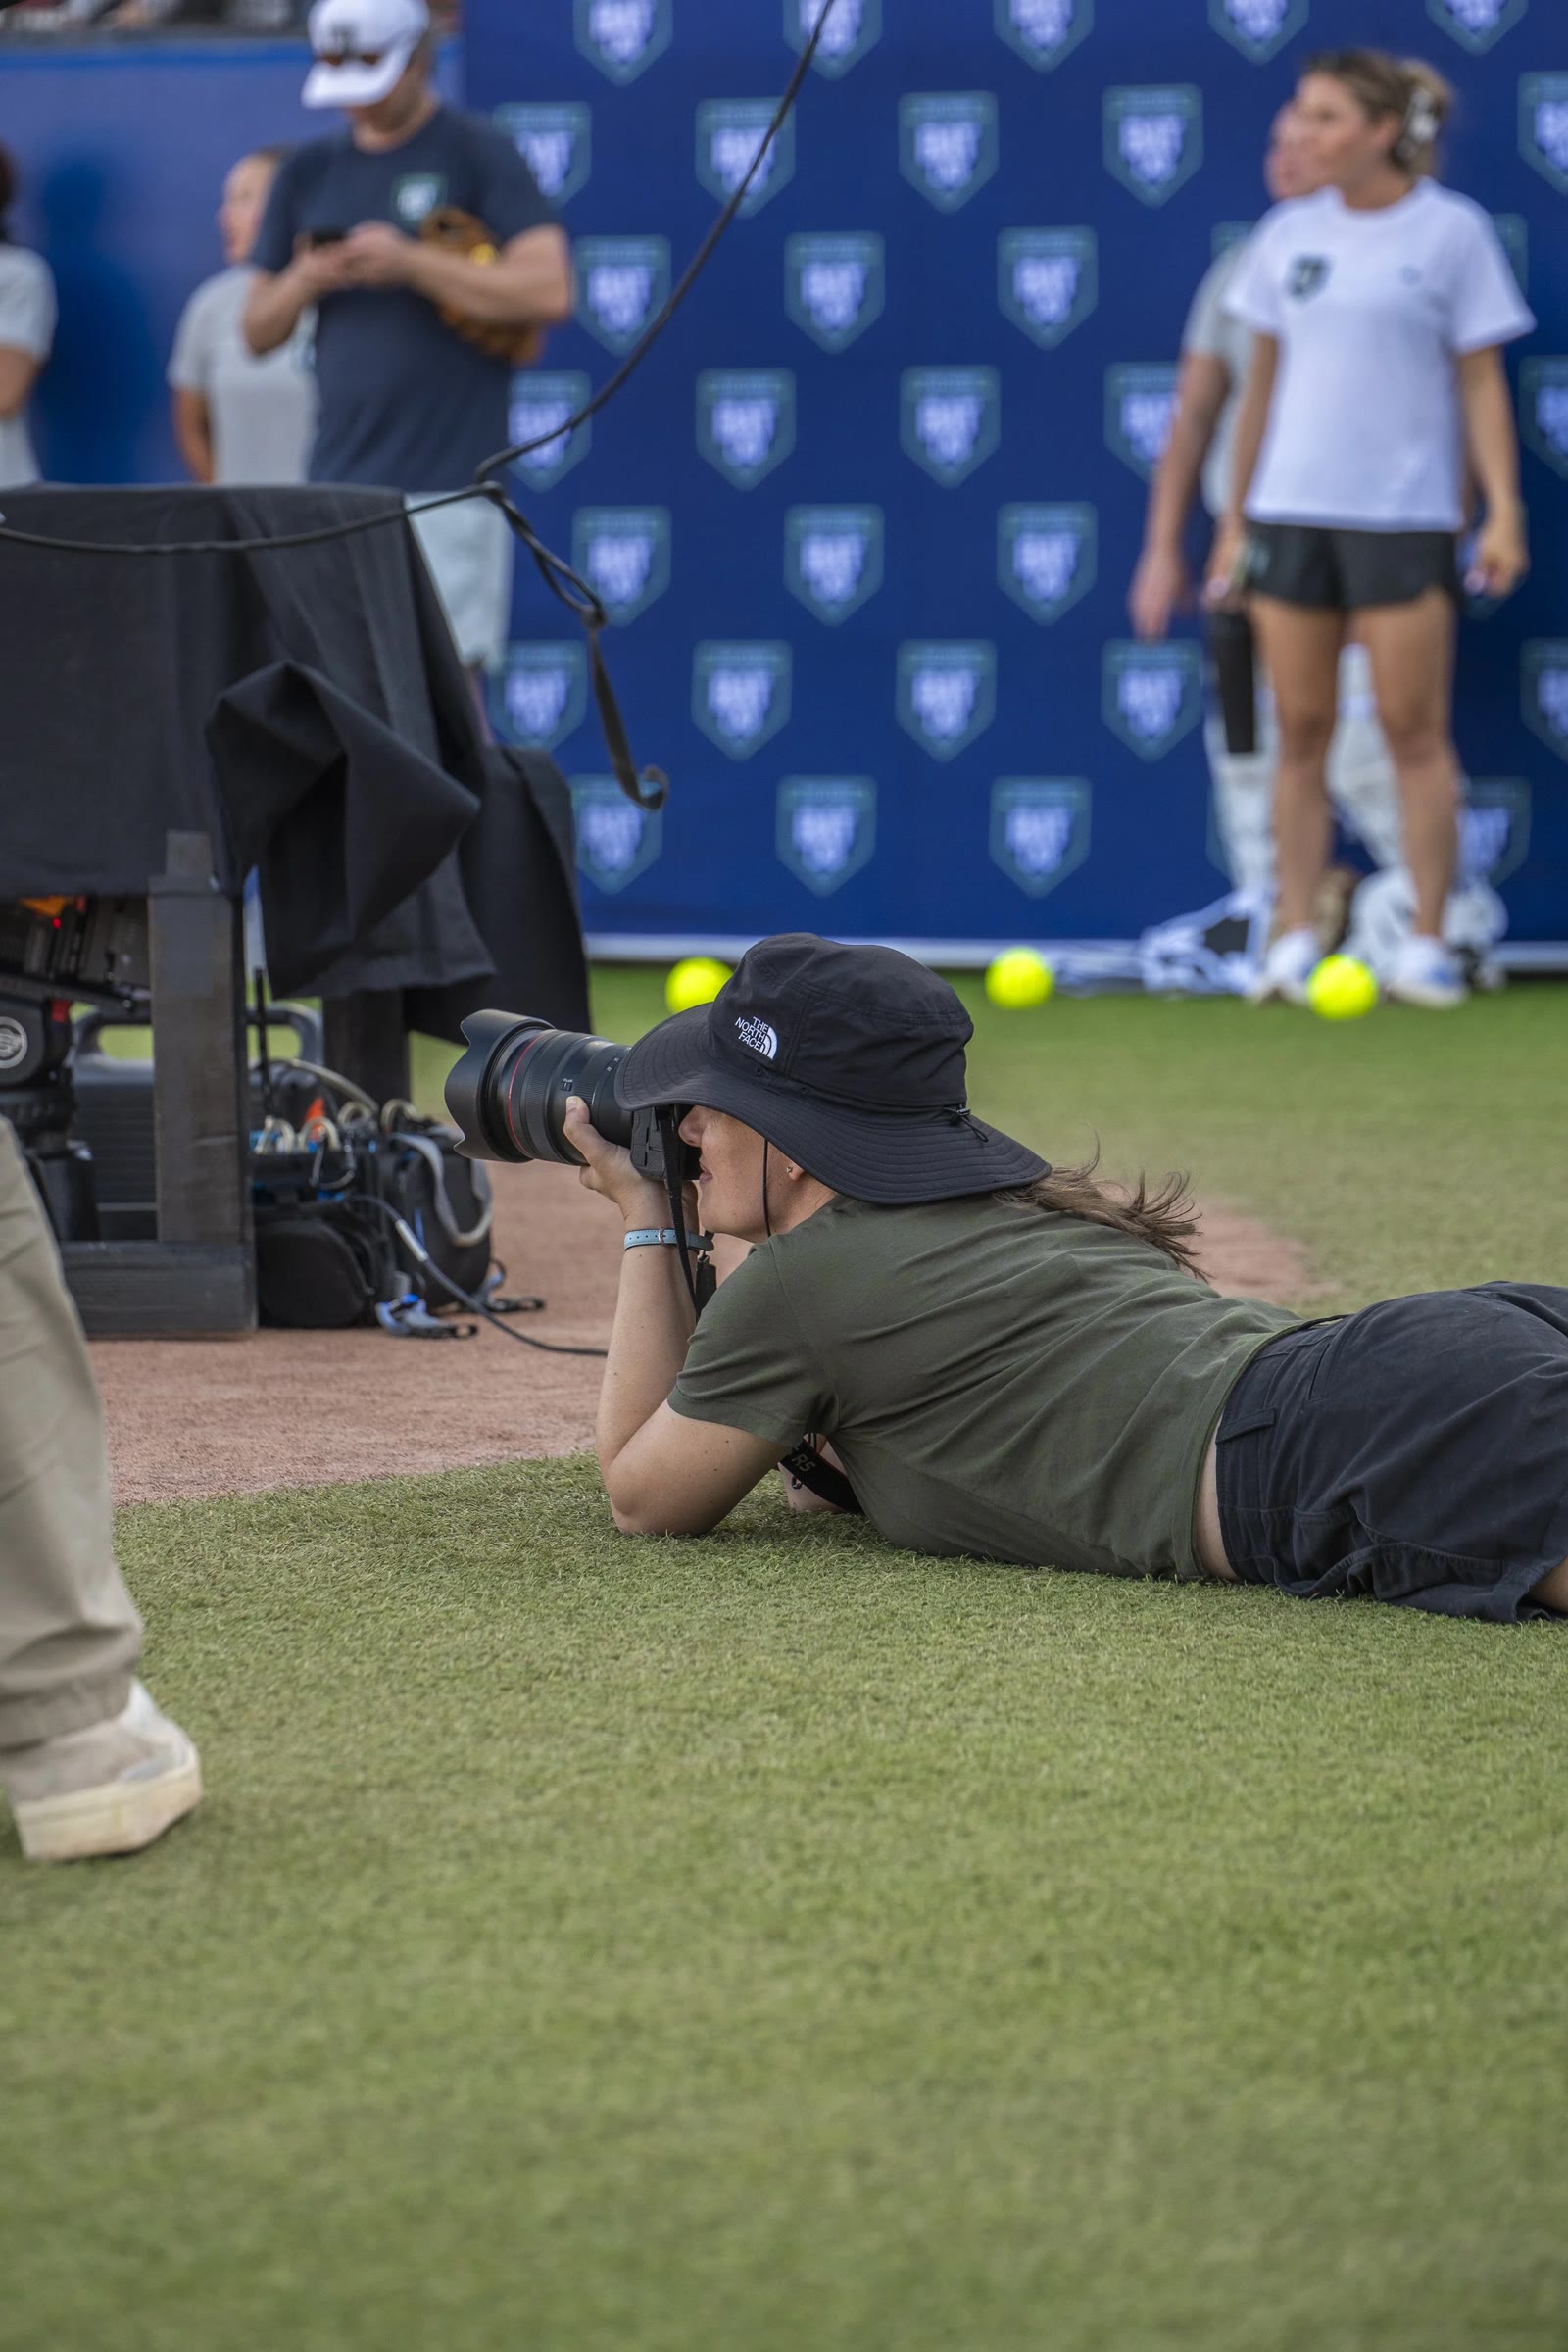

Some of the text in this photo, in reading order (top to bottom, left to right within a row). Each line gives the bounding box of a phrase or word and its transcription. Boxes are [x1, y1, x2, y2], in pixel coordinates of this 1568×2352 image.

[734, 1017, 766, 1042] NORTH
[753, 1016, 769, 1033] THE
[738, 1031, 761, 1051] FACE
[791, 1453, 816, 1472] R5
